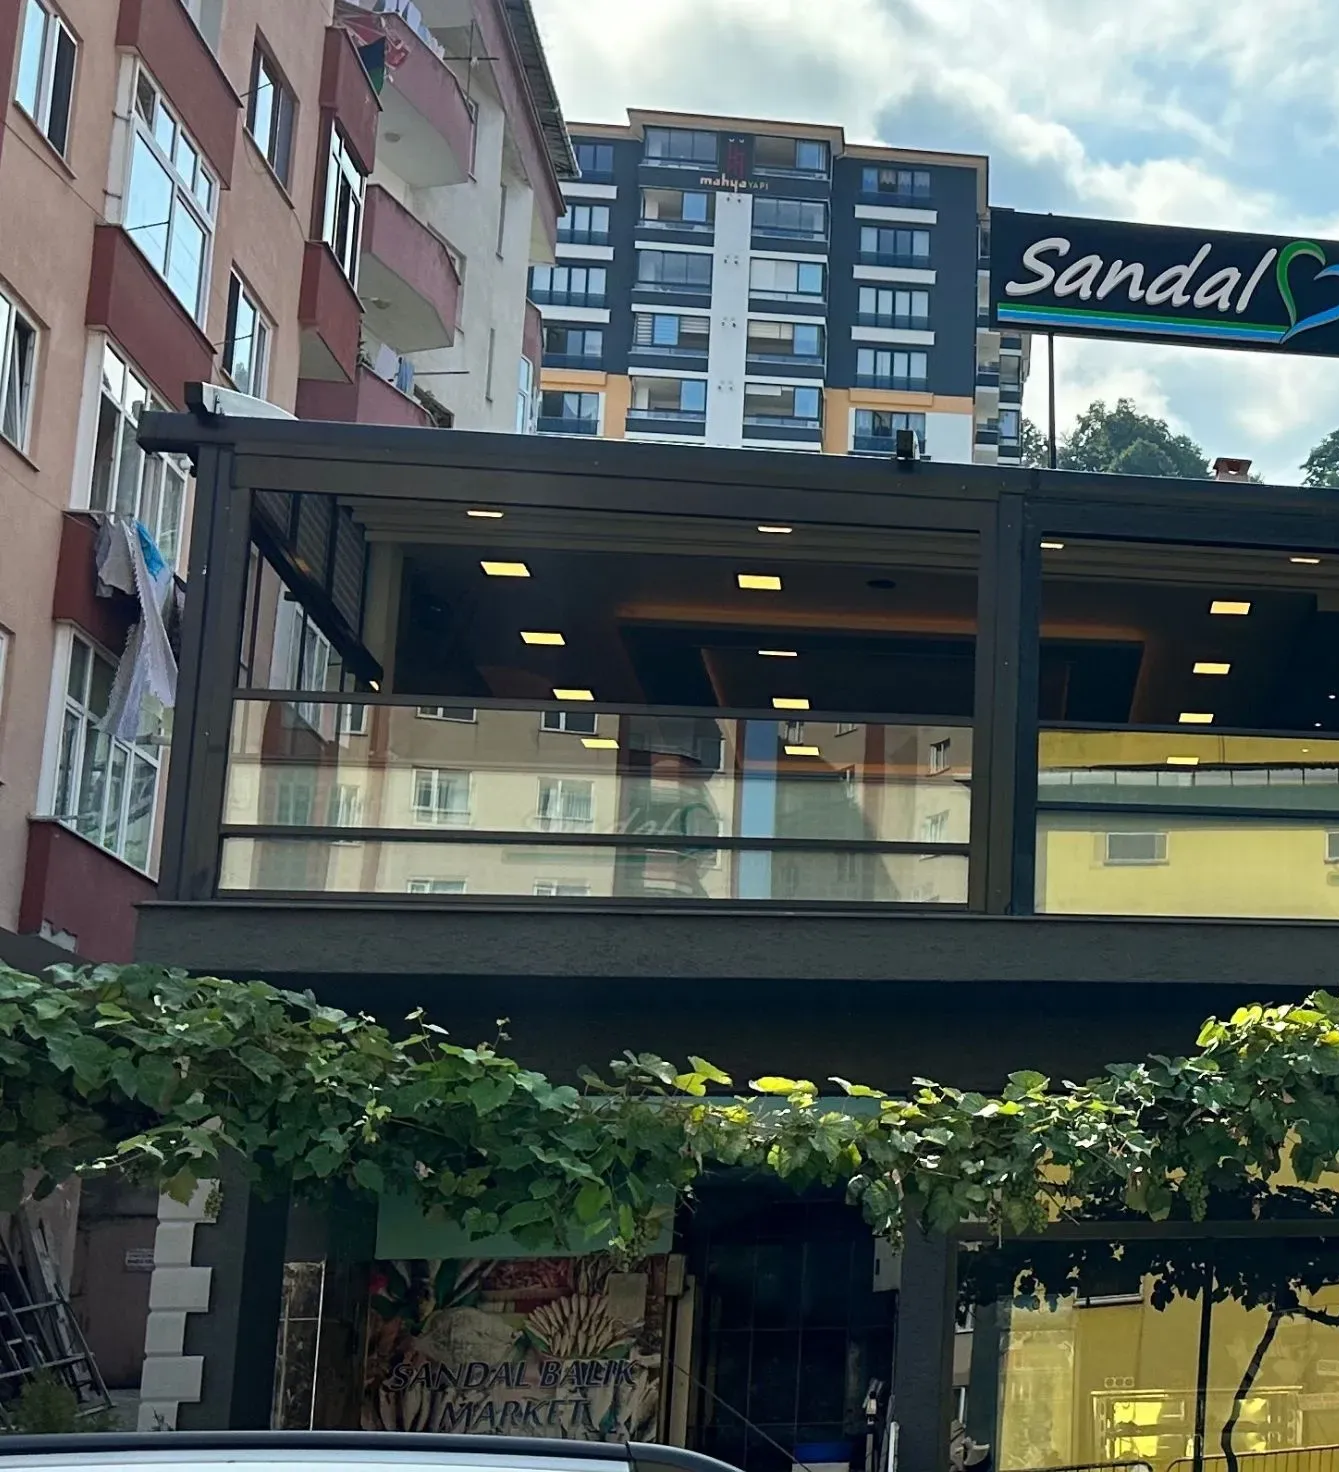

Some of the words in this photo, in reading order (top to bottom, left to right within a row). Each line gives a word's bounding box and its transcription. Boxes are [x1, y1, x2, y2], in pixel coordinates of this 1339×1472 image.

[700, 173, 747, 193] mahya
[1005, 237, 1277, 314] Sandal
[388, 1358, 532, 1391] SANDAL
[540, 1358, 640, 1387] BALIK
[437, 1399, 592, 1433] MARKET
